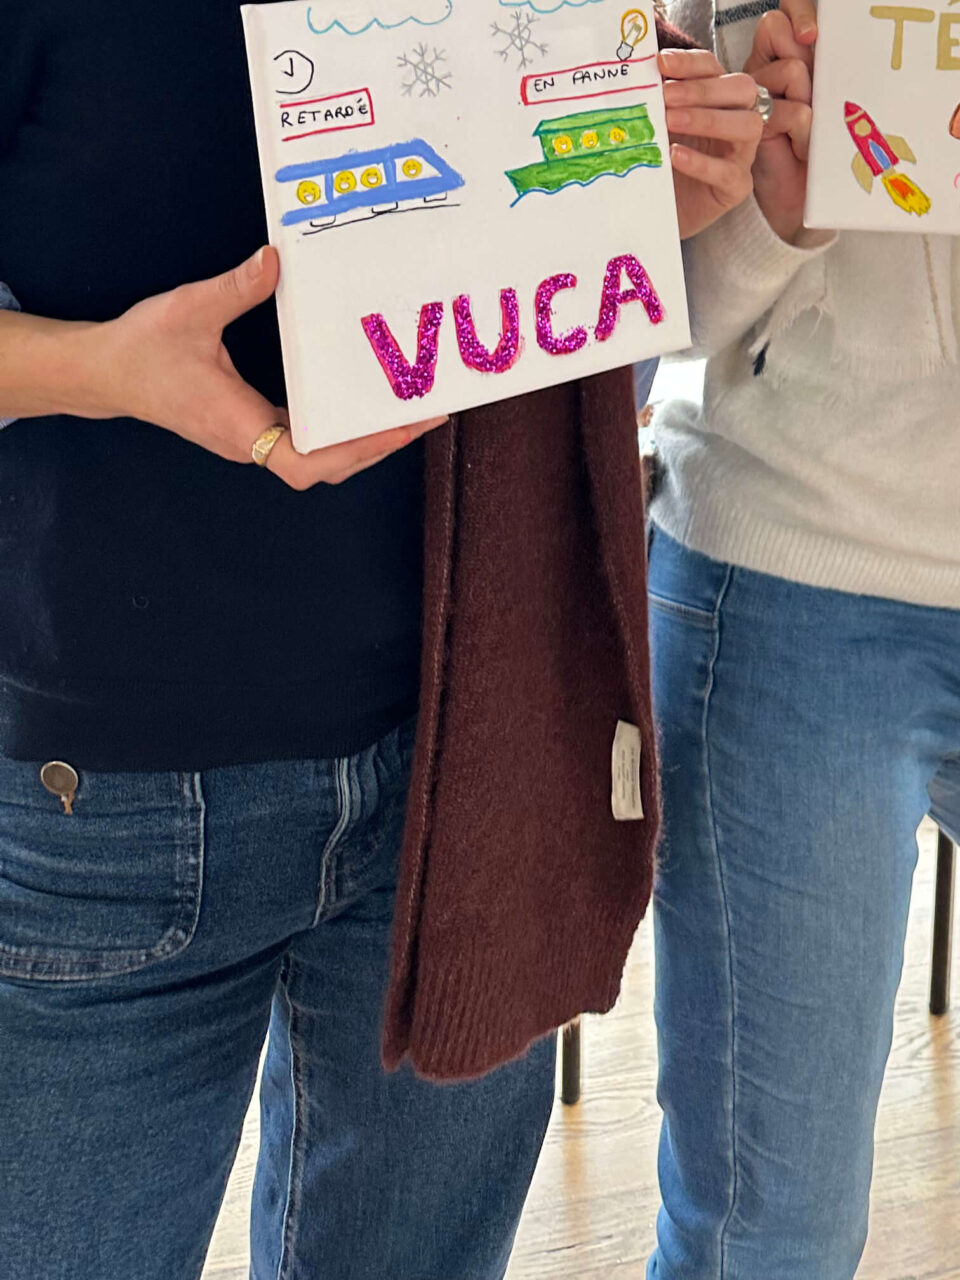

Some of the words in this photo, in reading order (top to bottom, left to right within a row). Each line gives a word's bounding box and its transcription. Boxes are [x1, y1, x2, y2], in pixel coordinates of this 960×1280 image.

[534, 77, 555, 92] EN
[572, 64, 630, 84] PANNE
[281, 98, 368, 127] RETARDÉ
[361, 253, 665, 401] VUCA
